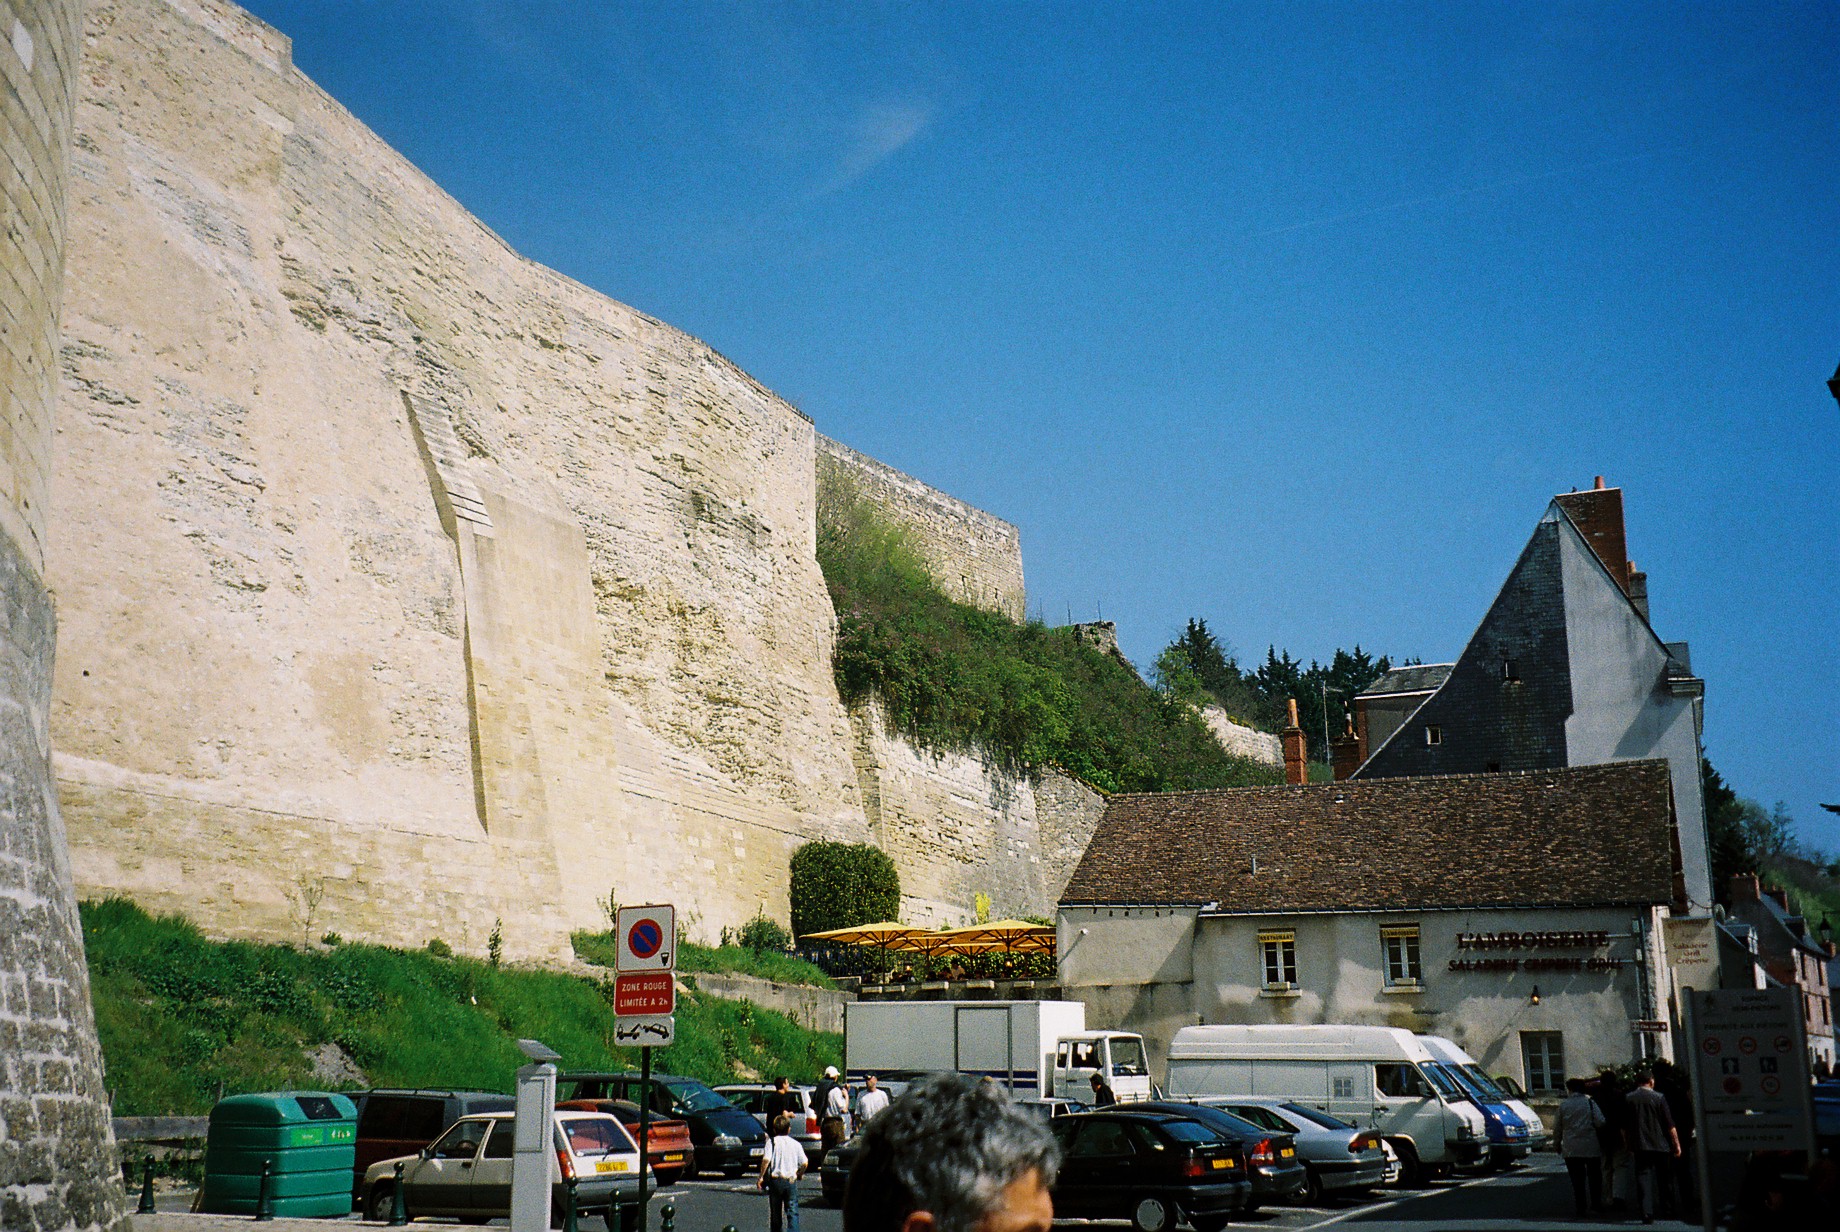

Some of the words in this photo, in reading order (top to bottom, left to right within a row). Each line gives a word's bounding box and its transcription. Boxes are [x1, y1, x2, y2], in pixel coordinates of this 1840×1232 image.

[1456, 931, 1610, 950] L'AMBOISERIE
[1587, 957, 1623, 970] GRILL
[621, 983, 641, 992] ZONE
[643, 981, 668, 991] ROUGE
[620, 997, 648, 1007] LIMITÉE
[658, 997, 669, 1006] 2h
